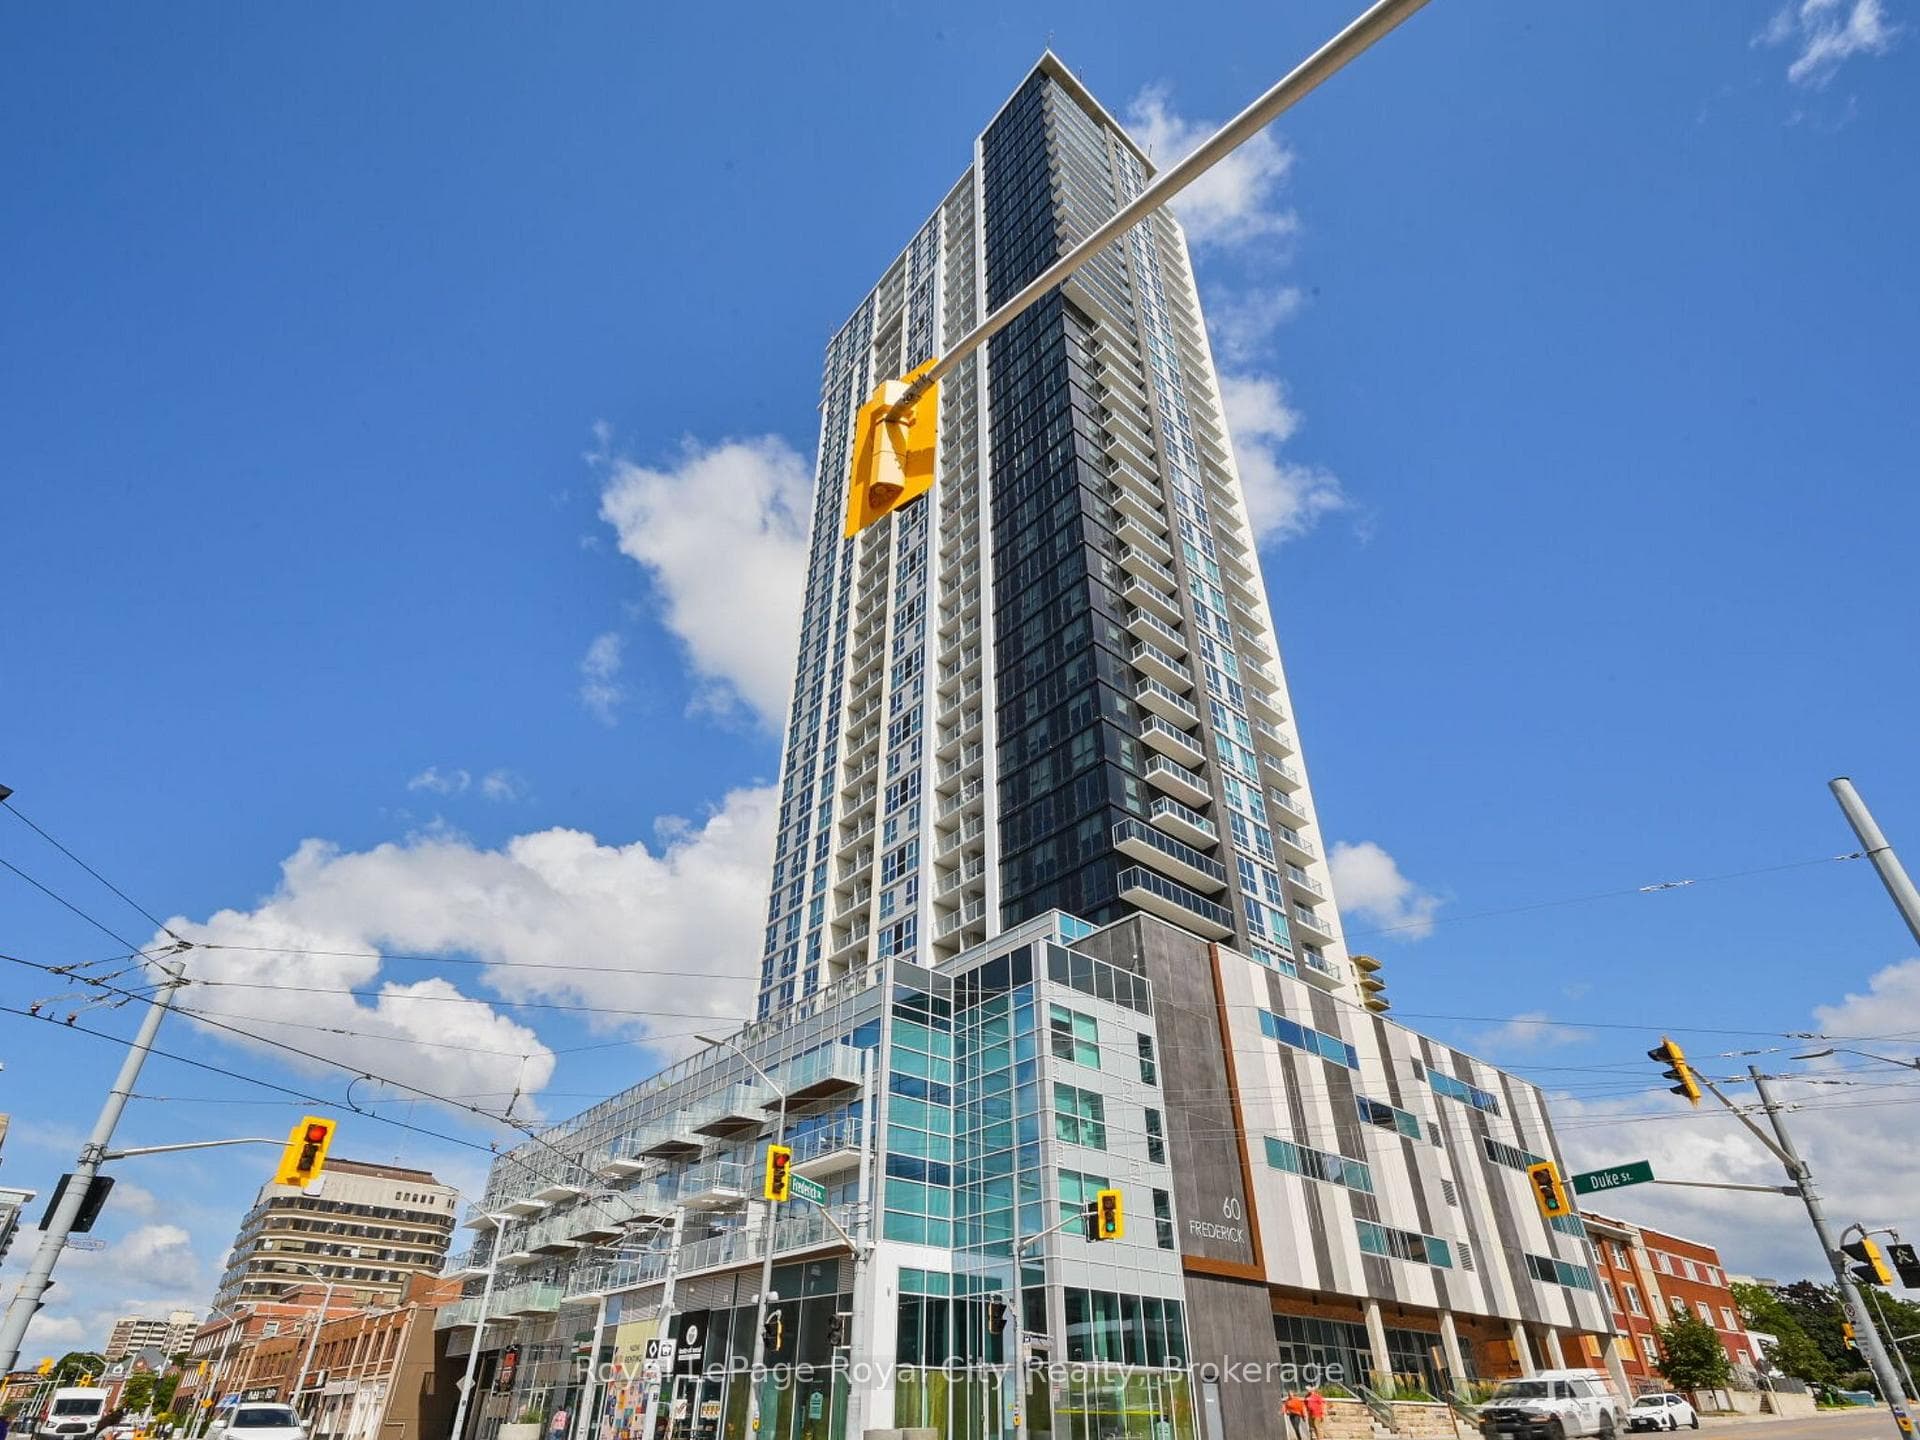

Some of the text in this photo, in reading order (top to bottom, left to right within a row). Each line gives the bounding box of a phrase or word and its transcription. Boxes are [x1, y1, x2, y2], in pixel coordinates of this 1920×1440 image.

[1590, 1171, 1620, 1189] Duke
[1223, 1197, 1241, 1220] 60
[1189, 1220, 1245, 1243] FREDERICK
